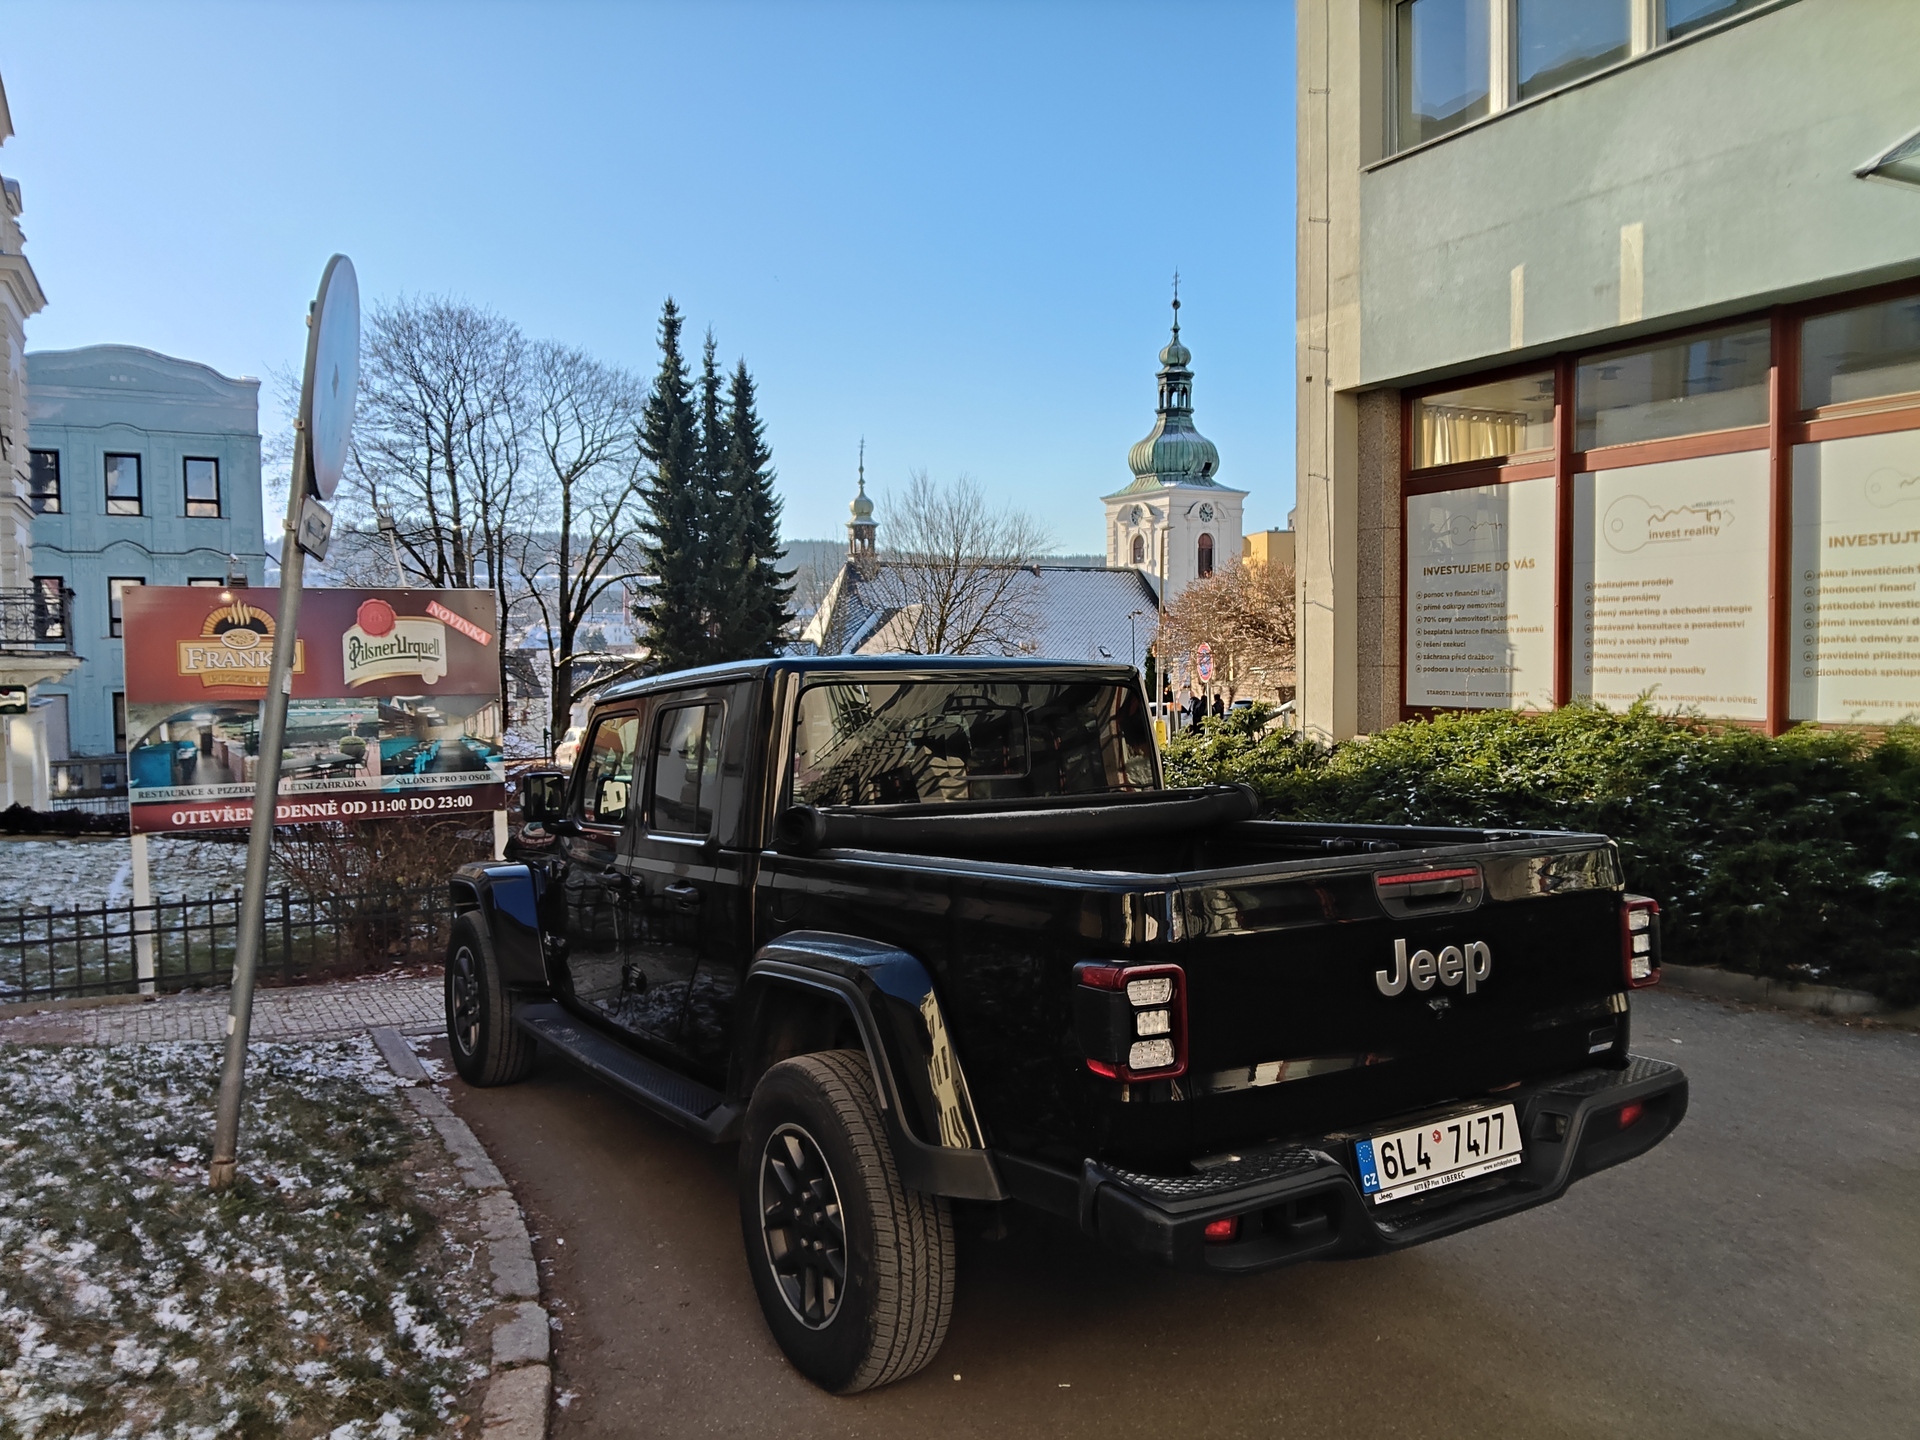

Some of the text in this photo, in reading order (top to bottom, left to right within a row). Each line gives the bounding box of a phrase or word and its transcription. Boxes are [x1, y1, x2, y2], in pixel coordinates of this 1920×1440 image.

[1649, 525, 1720, 539] invest reality
[1423, 557, 1535, 576] INVESTUJEME DO VÁS
[1593, 578, 1674, 589] realizujeme prodeje
[1880, 582, 1916, 592] financí
[1455, 589, 1479, 597] finanční
[1622, 593, 1661, 603] pronájmy
[1619, 607, 1661, 617] marketing
[1670, 604, 1710, 615] obchodní
[1712, 604, 1752, 614] strategie
[430, 603, 487, 643] NOVINKA
[1637, 622, 1682, 631] konzultace
[1423, 628, 1453, 636] bezplatná
[1455, 627, 1479, 635] lustrace
[186, 647, 297, 669] FRANK
[349, 634, 440, 670] Pilsner Urquell
[1423, 665, 1448, 673] podpora
[440, 774, 456, 783] PRO
[468, 773, 492, 782] OSOB
[284, 779, 367, 791] LETNÍ ZAHRÁDKA
[138, 788, 203, 799] RESTAURACE
[276, 800, 338, 818] DENNĚ
[341, 801, 367, 815] OD
[371, 800, 406, 813] 11:00
[410, 797, 435, 811] DO
[437, 794, 473, 808] 23:00
[1376, 938, 1491, 996] Jeep
[1381, 1112, 1504, 1180] 6L4 7477
[1363, 1173, 1378, 1187] CZ
[1379, 1192, 1393, 1201] Jeep
[1414, 1184, 1424, 1192] AUTO
[1424, 1180, 1430, 1190] KP
[1441, 1171, 1466, 1184] LIBEREC
